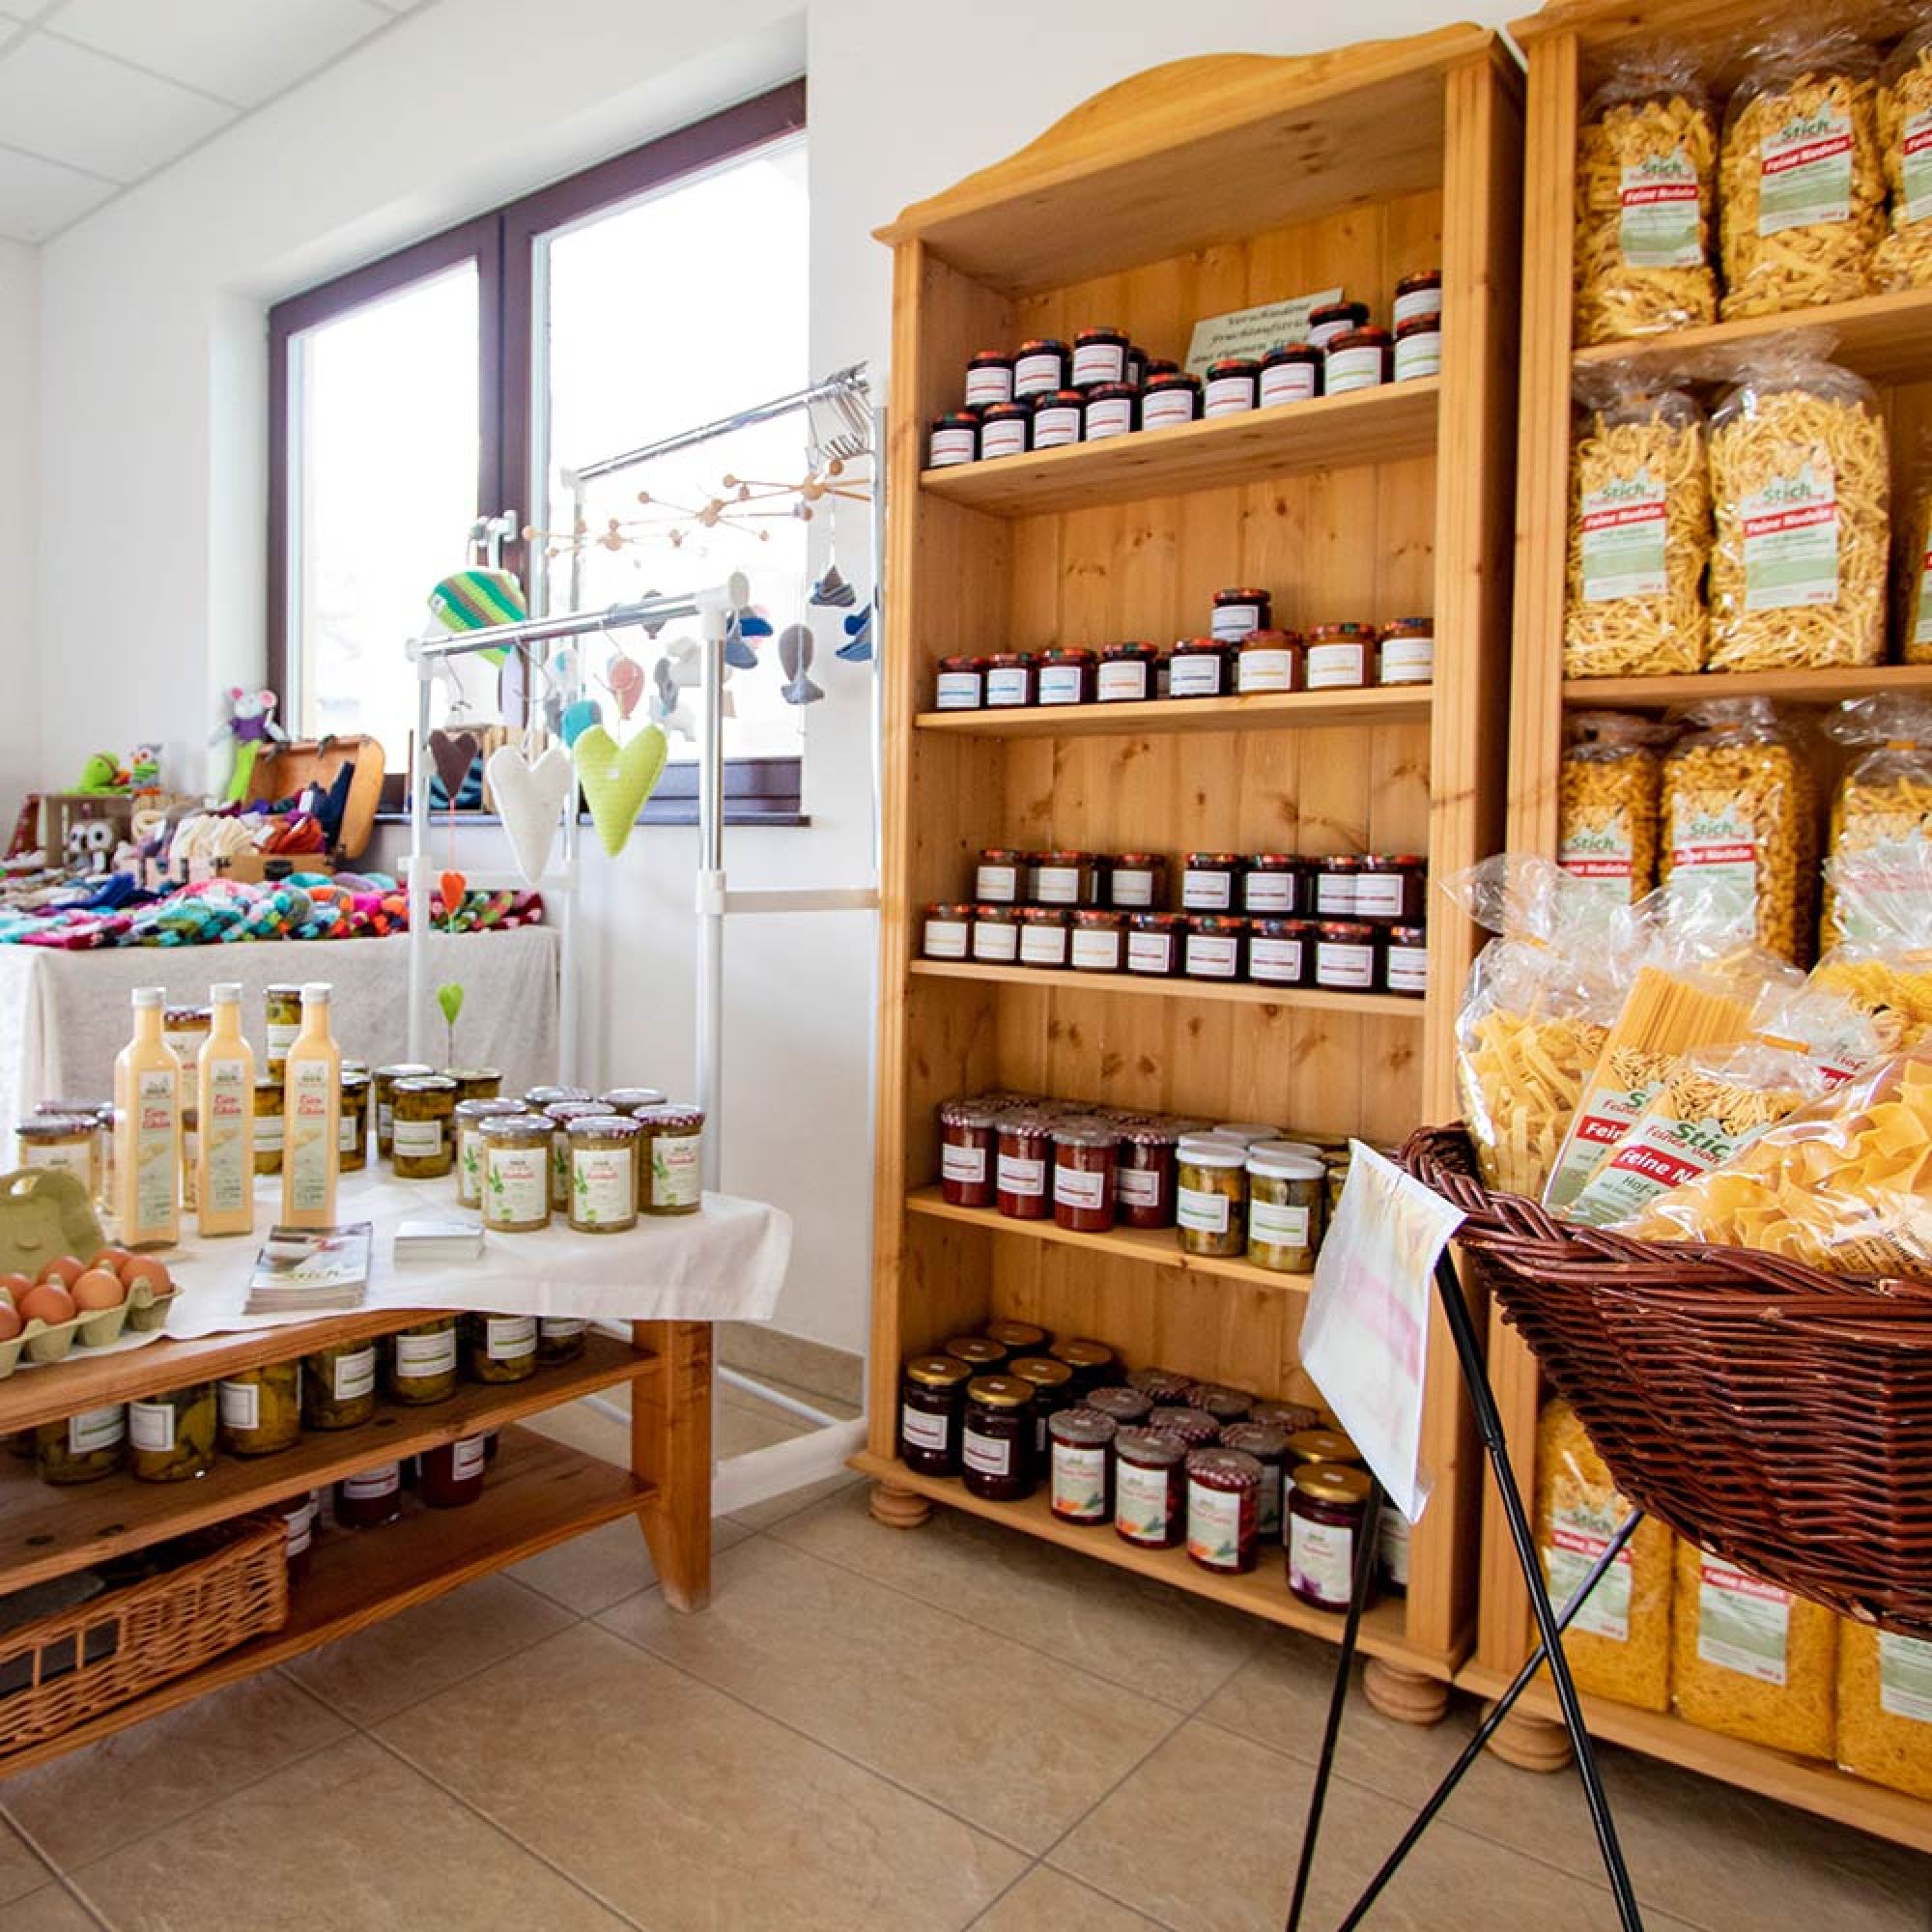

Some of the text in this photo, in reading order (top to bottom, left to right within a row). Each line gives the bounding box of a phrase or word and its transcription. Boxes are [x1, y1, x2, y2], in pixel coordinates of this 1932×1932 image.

[1585, 1122, 1623, 1141] Fein
[1669, 1123, 1732, 1156] Stic
[1620, 1150, 1670, 1176] Feine
